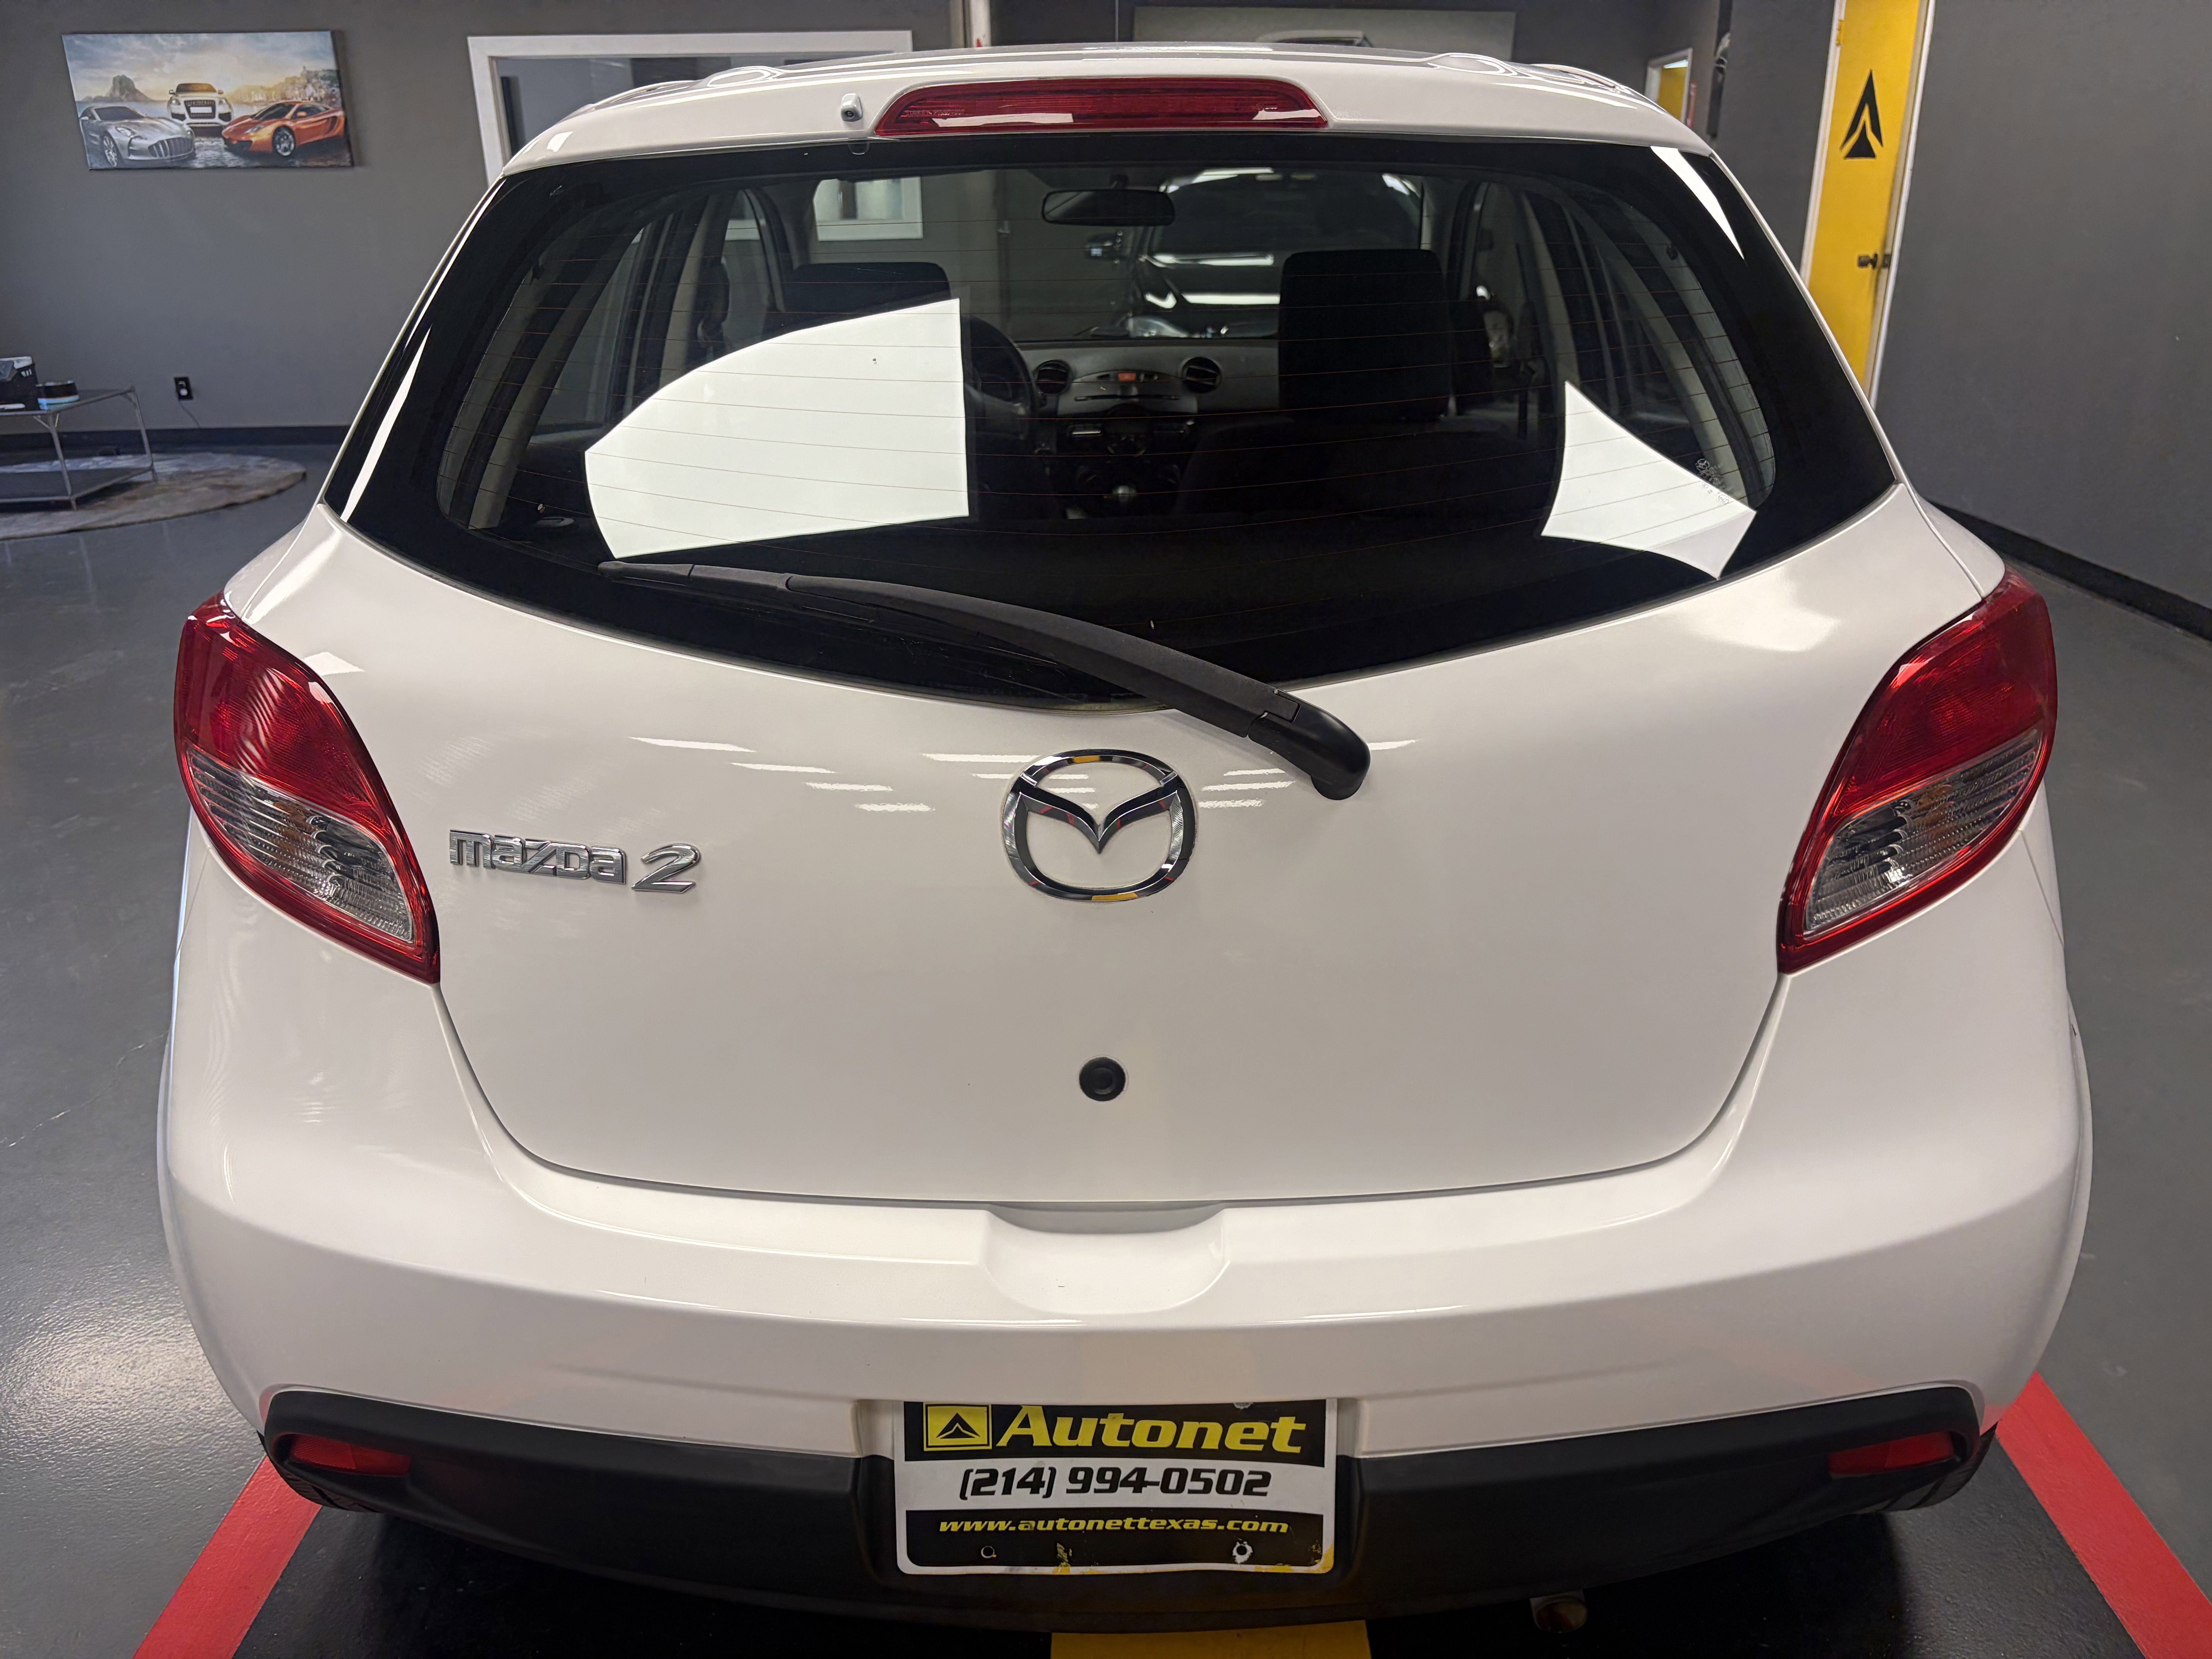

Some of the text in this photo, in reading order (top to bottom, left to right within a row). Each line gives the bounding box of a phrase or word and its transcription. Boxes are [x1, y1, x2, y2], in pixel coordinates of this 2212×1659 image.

[631, 843, 701, 894] 2
[996, 1405, 1307, 1454] Autonet
[958, 1466, 1272, 1501] (214) 994-0502
[938, 1516, 1289, 1534] www.autonettexas.com
